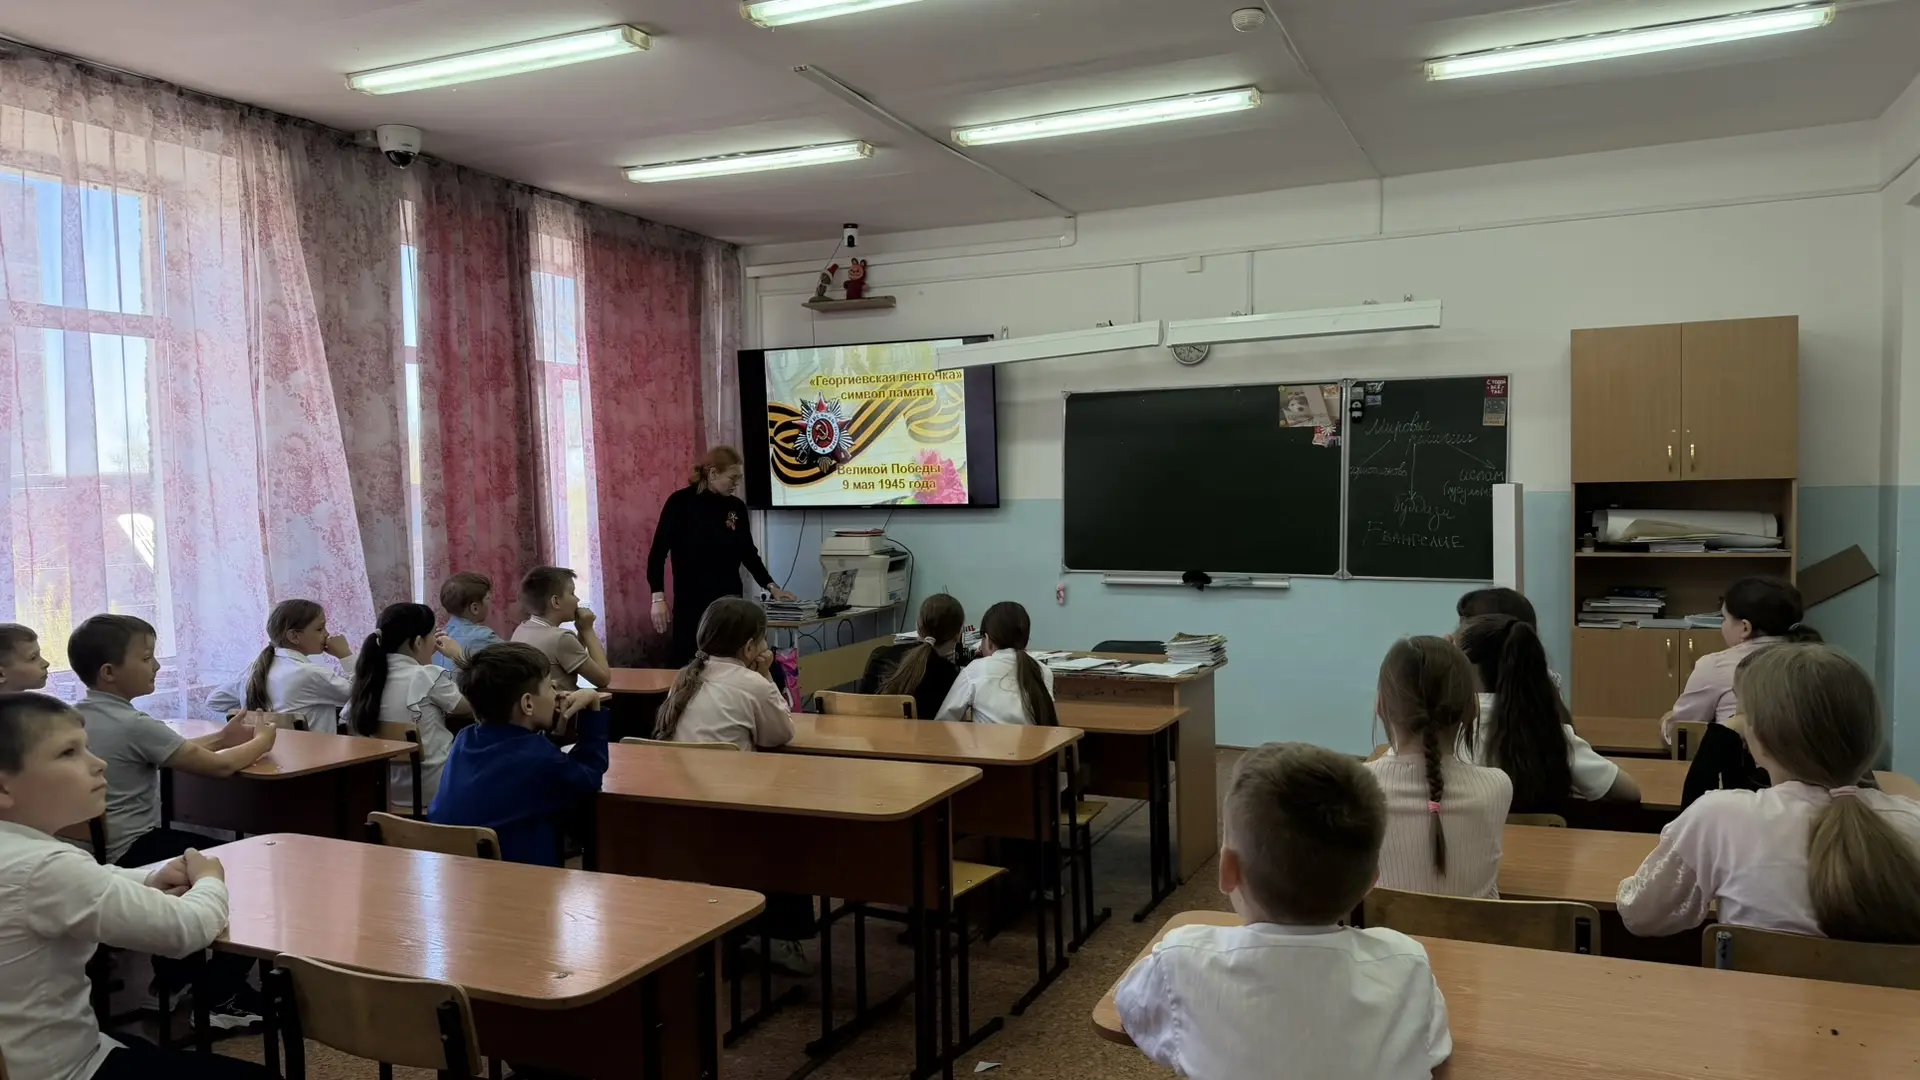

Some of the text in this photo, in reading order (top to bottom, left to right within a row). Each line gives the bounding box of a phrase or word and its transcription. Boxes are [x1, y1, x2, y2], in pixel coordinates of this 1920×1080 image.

[809, 370, 963, 388] «Георгиевская ленточка»
[840, 386, 934, 400] символ памяти
[837, 462, 941, 476] Великой Победы
[842, 478, 936, 491] 9 мая 1945 года
